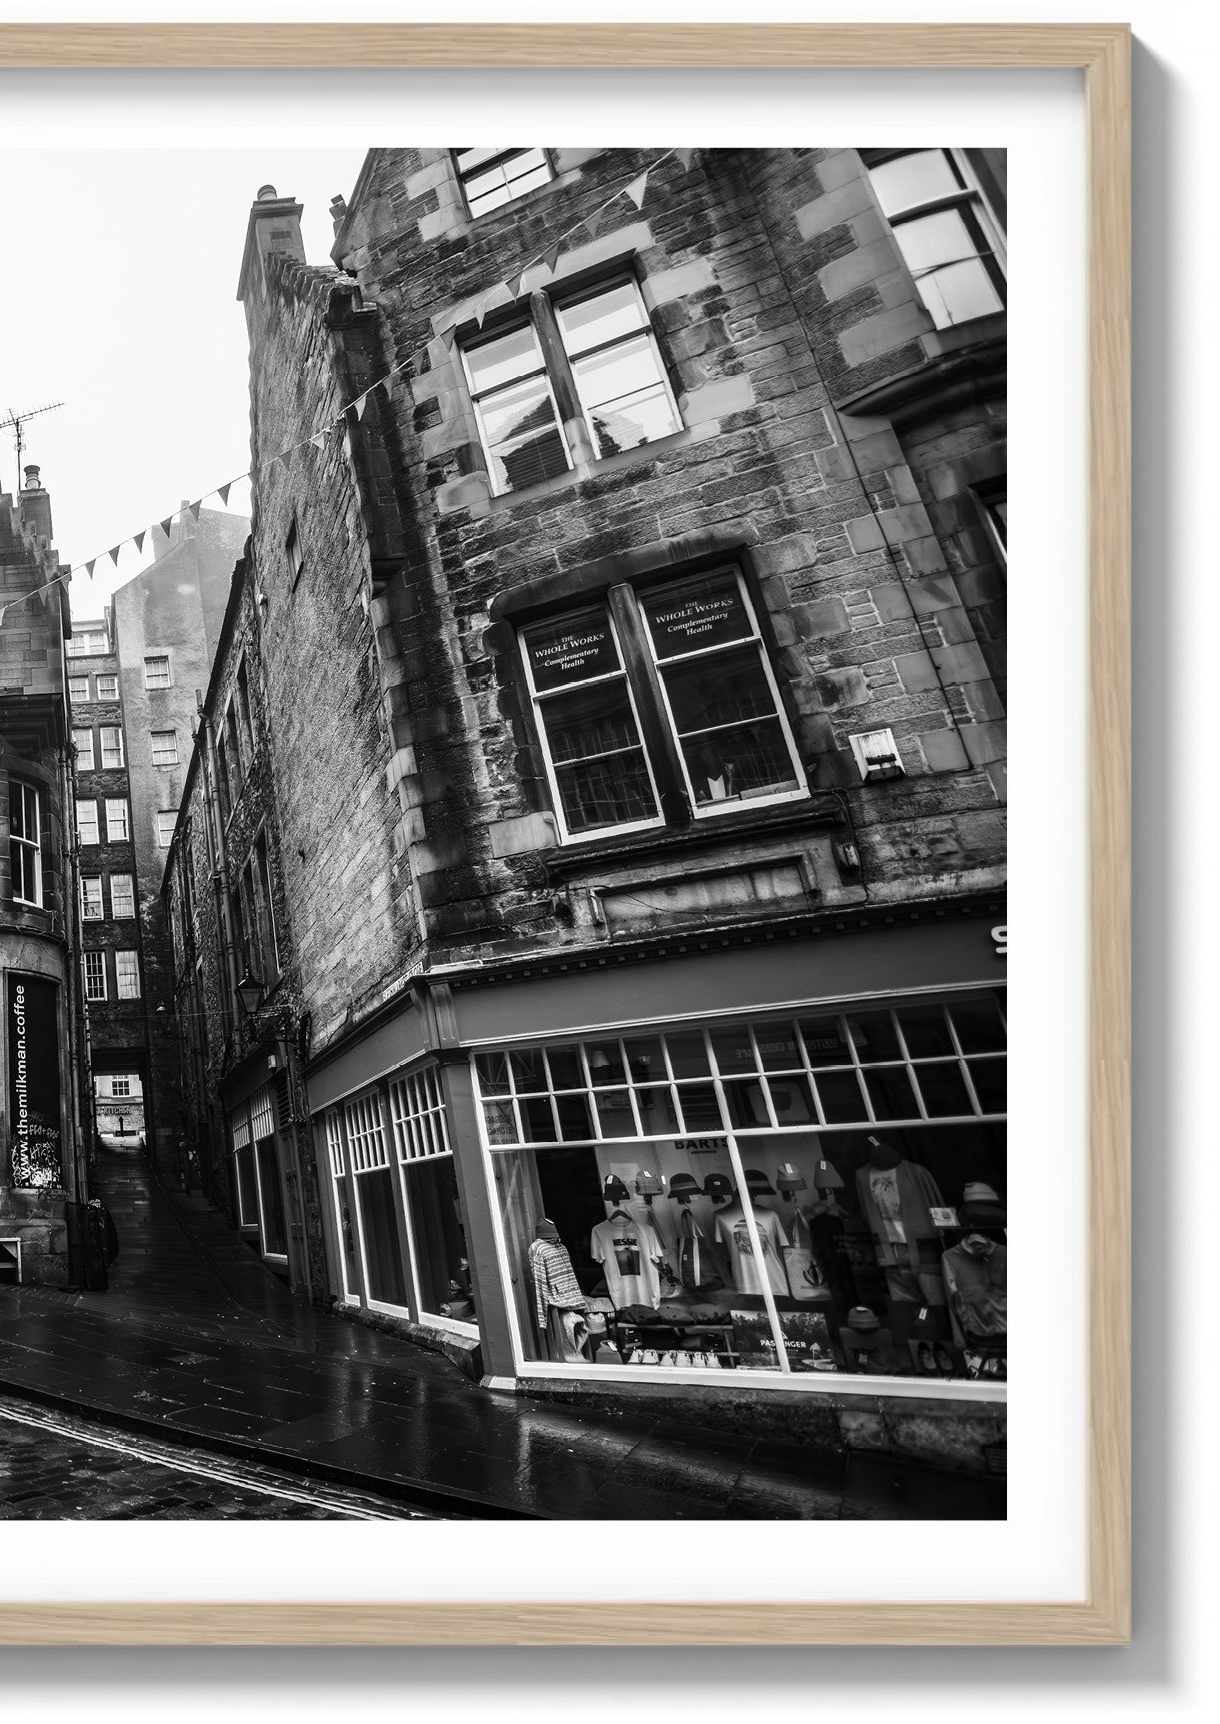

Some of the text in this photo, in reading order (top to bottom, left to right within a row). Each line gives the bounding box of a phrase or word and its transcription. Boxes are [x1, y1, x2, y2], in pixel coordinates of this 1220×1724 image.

[655, 598, 734, 625] WHOLE WORKS
[667, 611, 729, 634] Complementary
[561, 635, 574, 643] THE
[686, 623, 713, 636] Health
[534, 632, 605, 659] WHOLE WORKS
[544, 646, 599, 668] Complementary
[561, 658, 585, 670] Health
[14, 985, 29, 1186] www.themilkman.coffee
[760, 1339, 807, 1348] PASNGER
